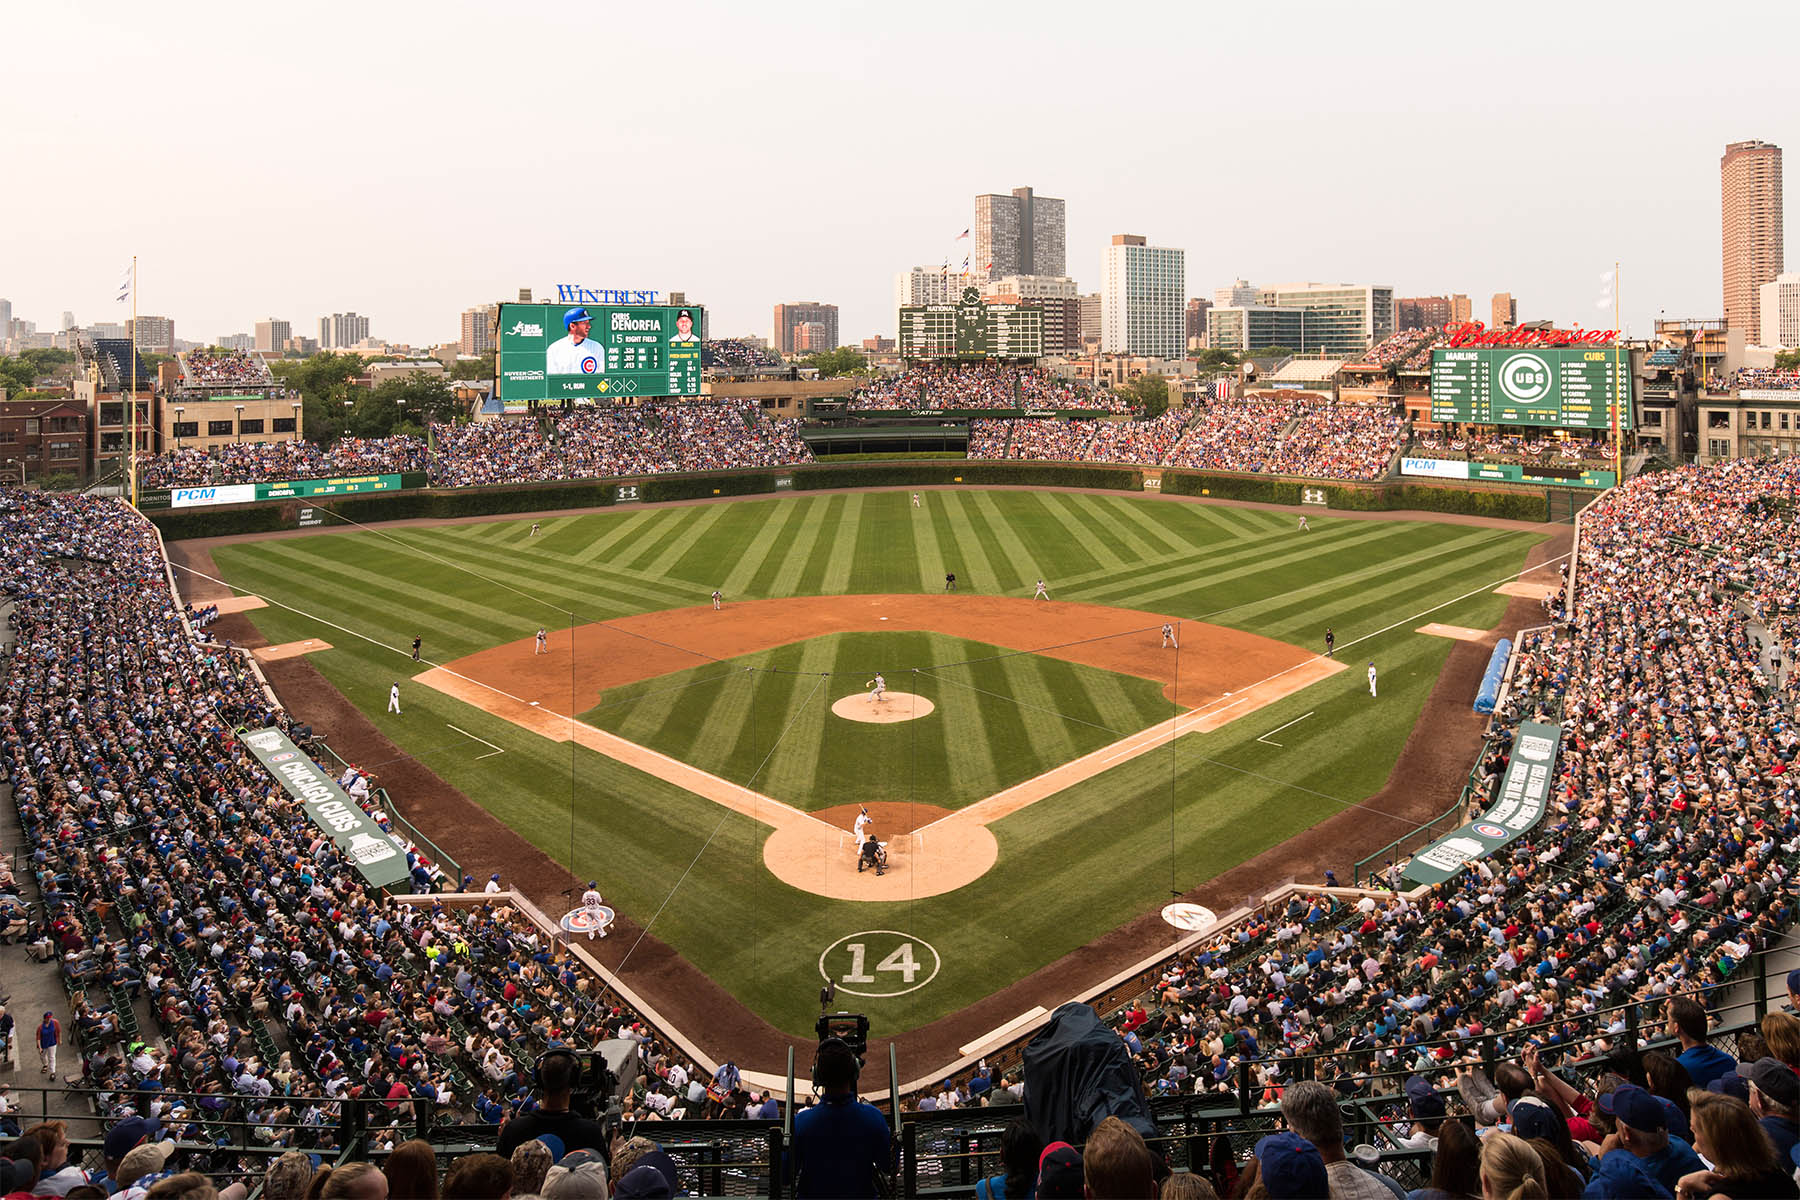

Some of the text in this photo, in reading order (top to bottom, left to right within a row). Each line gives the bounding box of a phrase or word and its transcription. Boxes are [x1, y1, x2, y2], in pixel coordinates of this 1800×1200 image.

[557, 284, 658, 304] WINTRUST
[611, 312, 630, 320] CHRIS
[611, 319, 661, 331] DENORFIA
[611, 334, 657, 343] 15 RIGHT FIELD
[1443, 321, 1621, 347] Budweiser
[1445, 352, 1478, 361] MARLINS
[1584, 352, 1606, 361] CUBS
[1405, 459, 1437, 471] PCM
[176, 488, 216, 501] PCM
[279, 761, 335, 804] CHICAGO
[316, 801, 362, 833] CUBS
[586, 898, 596, 906] 33
[842, 943, 921, 983] 14
